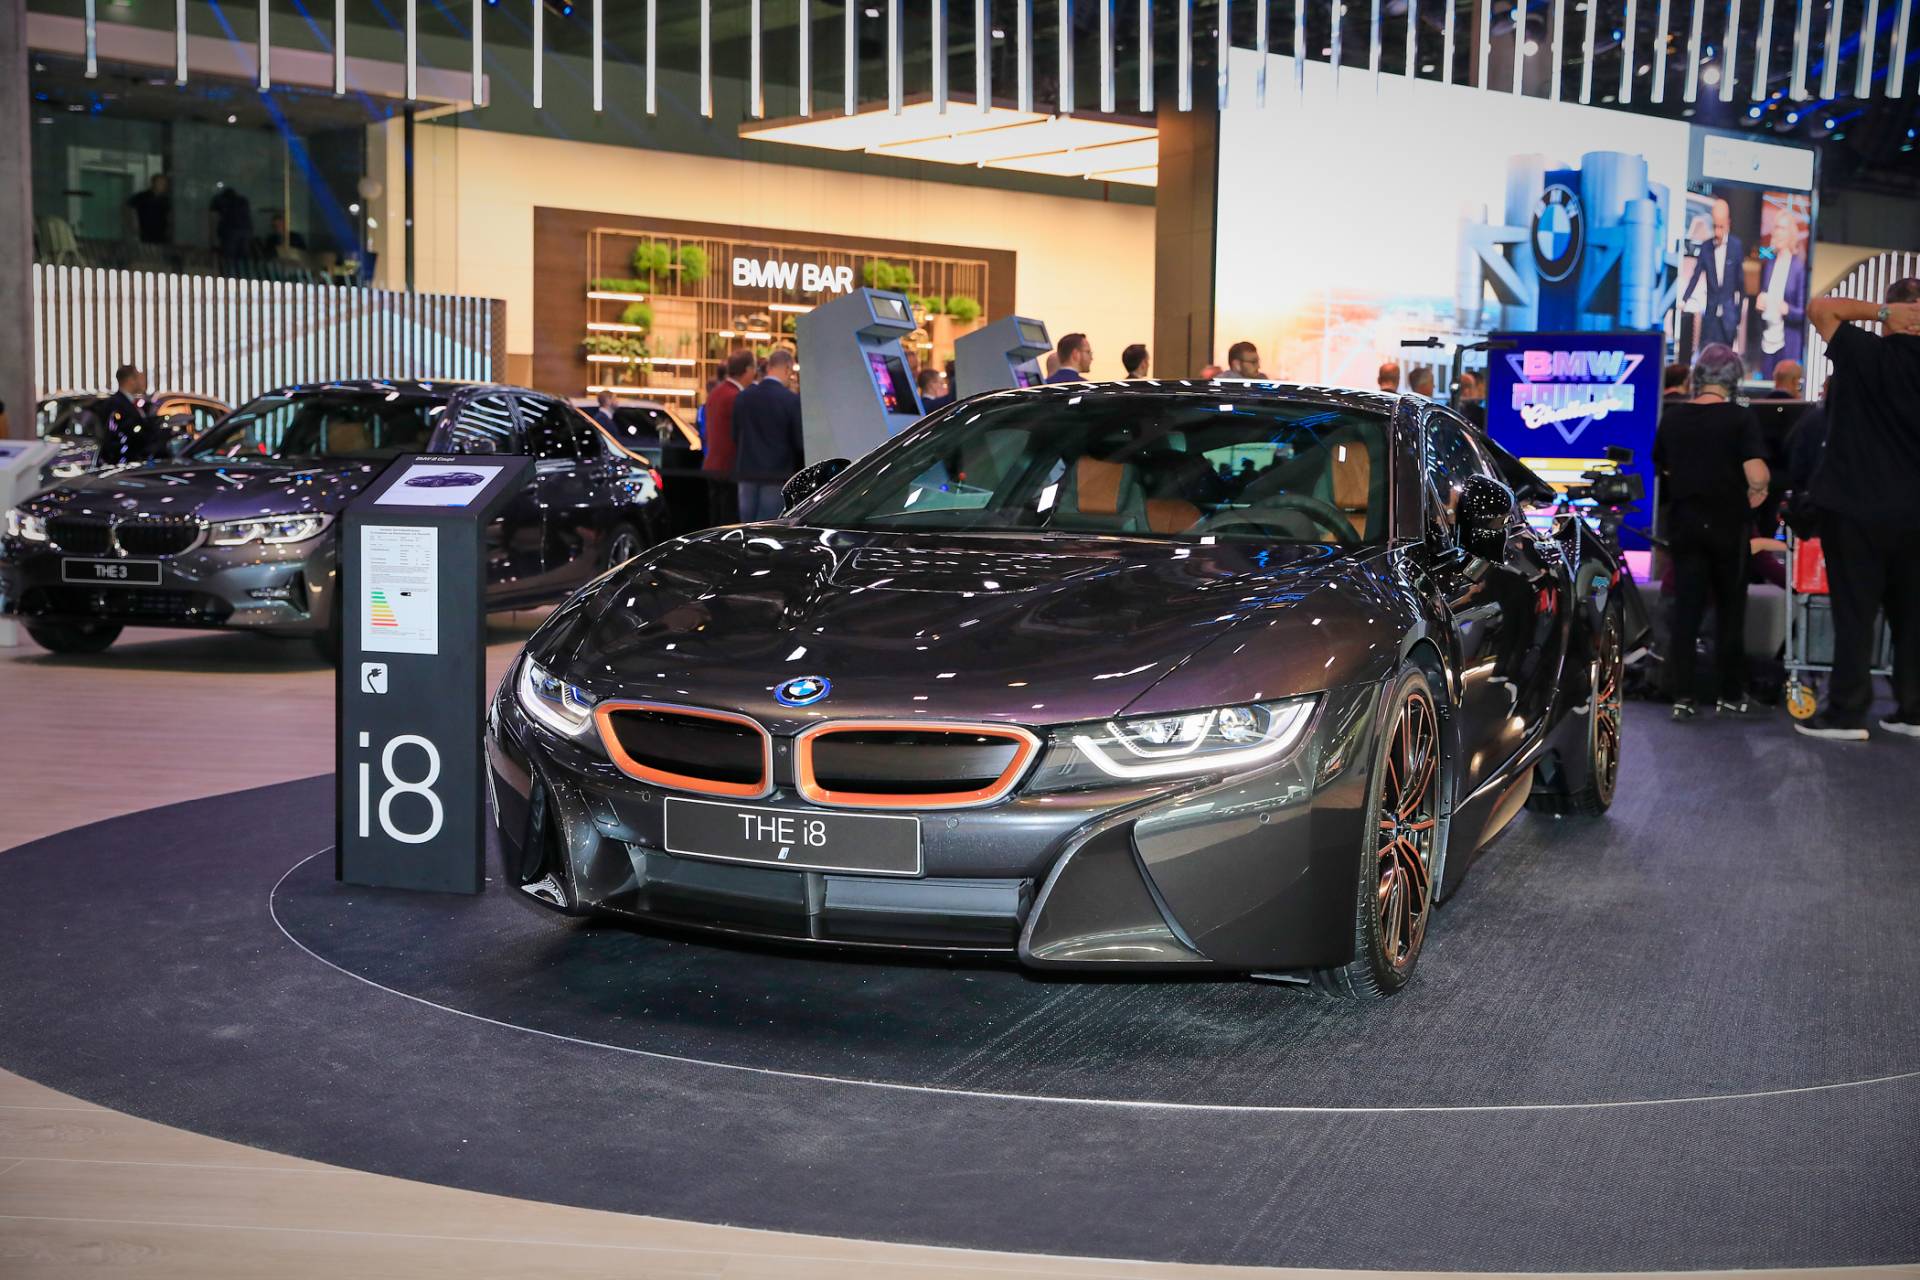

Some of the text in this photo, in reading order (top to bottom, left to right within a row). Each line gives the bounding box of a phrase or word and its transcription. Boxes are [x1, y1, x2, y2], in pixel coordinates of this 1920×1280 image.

[733, 257, 854, 294] BMW BAR
[1522, 350, 1625, 378] BMW
[94, 564, 128, 579] THE 3
[358, 731, 444, 844] i8
[737, 813, 827, 847] THE i8
